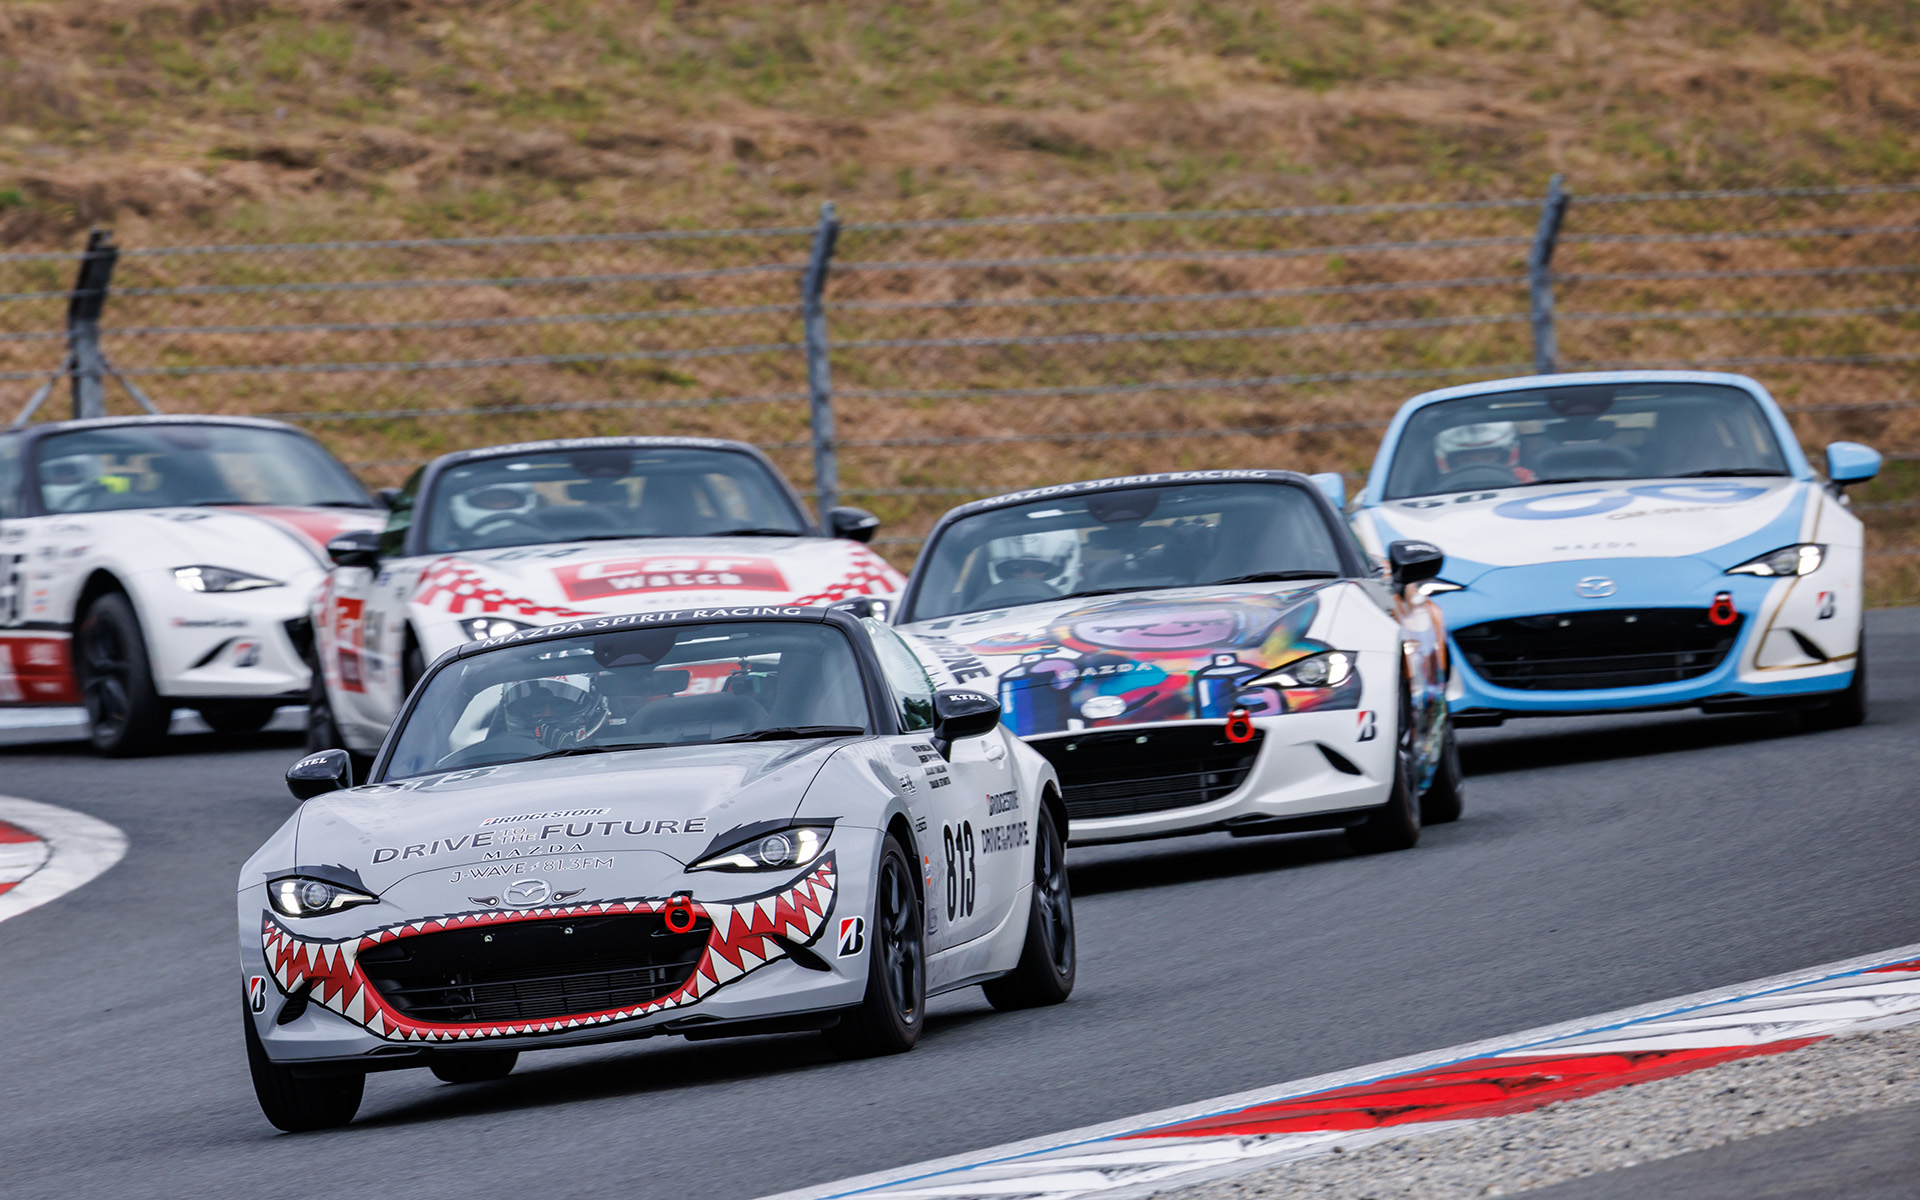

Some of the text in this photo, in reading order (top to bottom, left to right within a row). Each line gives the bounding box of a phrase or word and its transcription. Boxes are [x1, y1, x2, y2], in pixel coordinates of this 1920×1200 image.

[982, 470, 1268, 507] MAZDA SPIRIT RACING
[577, 558, 756, 580] Car
[607, 572, 744, 590] Watch
[481, 606, 801, 649] MAZDA SPIRIT RACING
[1058, 662, 1153, 680] MAZDA
[481, 808, 611, 827] BRIDGESTONE
[371, 817, 707, 865] DRIVE TO THE FUTURE
[482, 843, 584, 860] MAZDA
[449, 856, 615, 884] J-WAVE 81.3FM
[942, 818, 977, 923] 813
